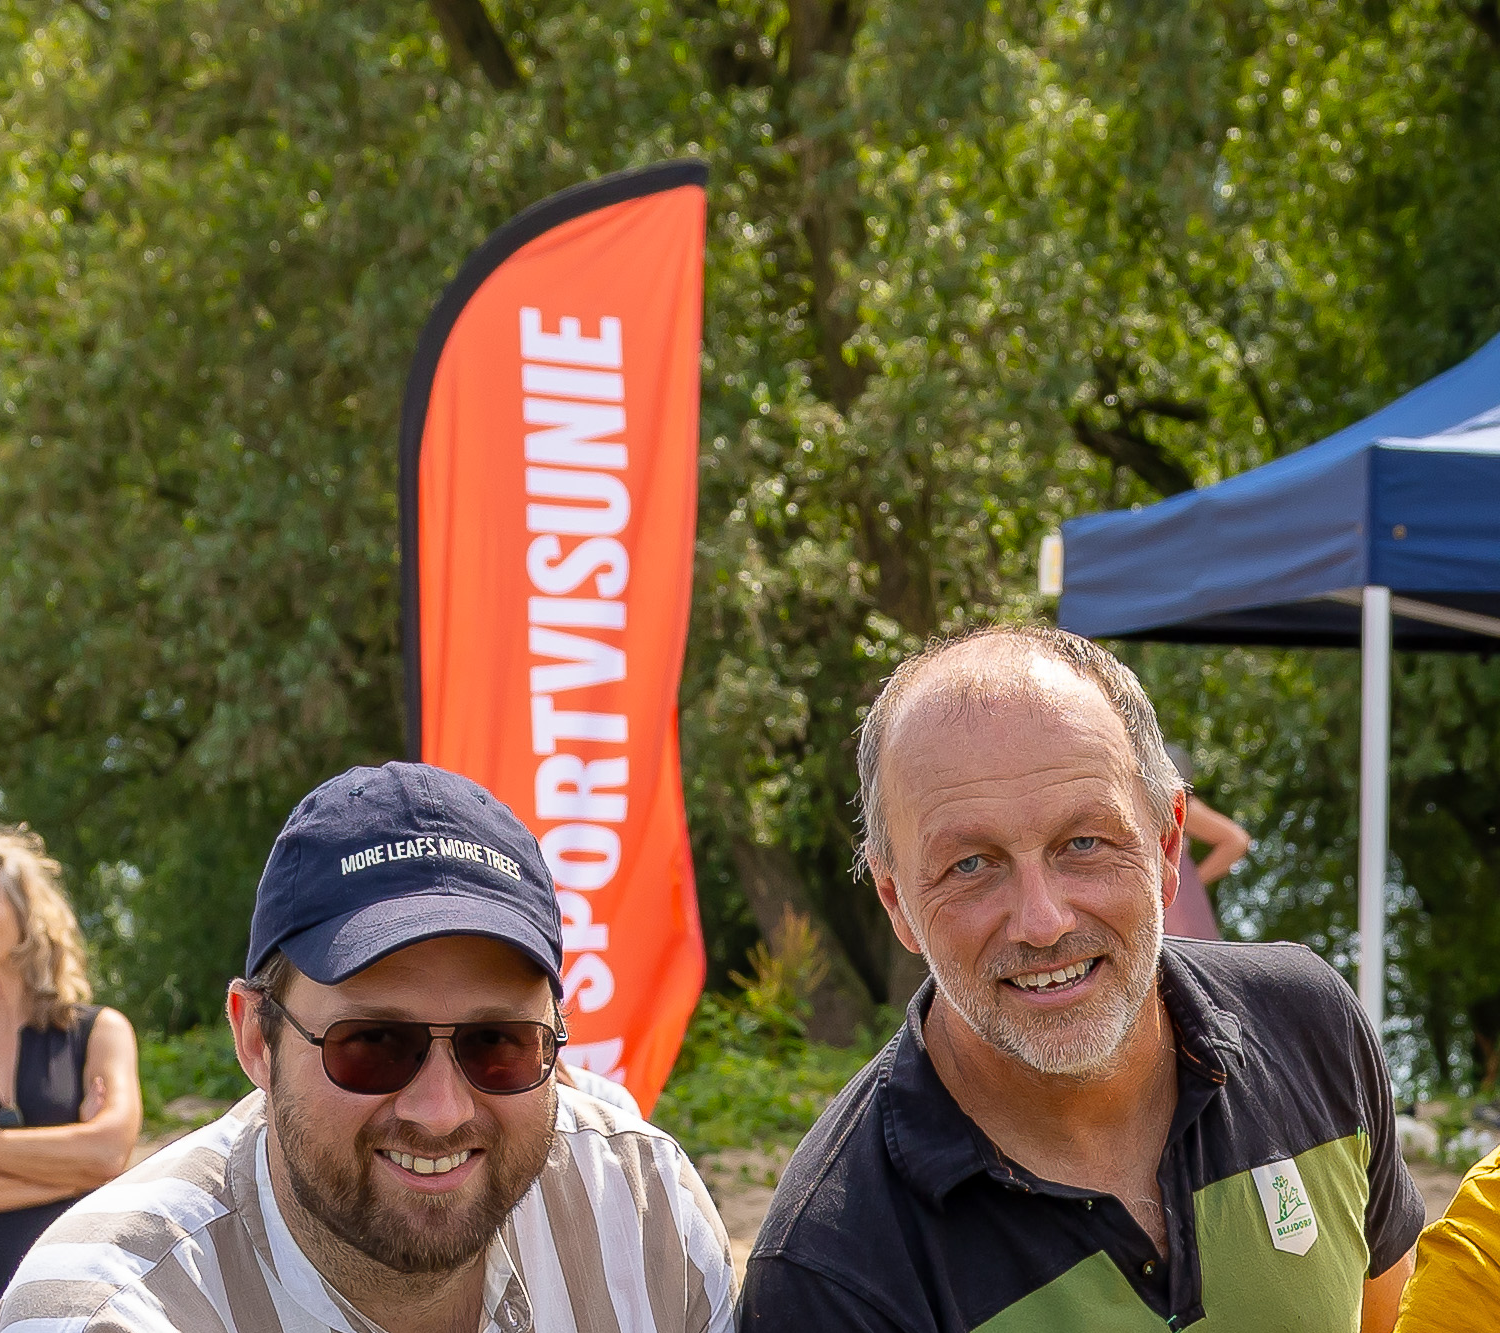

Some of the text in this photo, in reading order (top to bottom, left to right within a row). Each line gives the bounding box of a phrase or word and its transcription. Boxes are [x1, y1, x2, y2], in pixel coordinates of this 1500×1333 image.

[340, 837, 521, 881] MORE LEAFS MORE TREES
